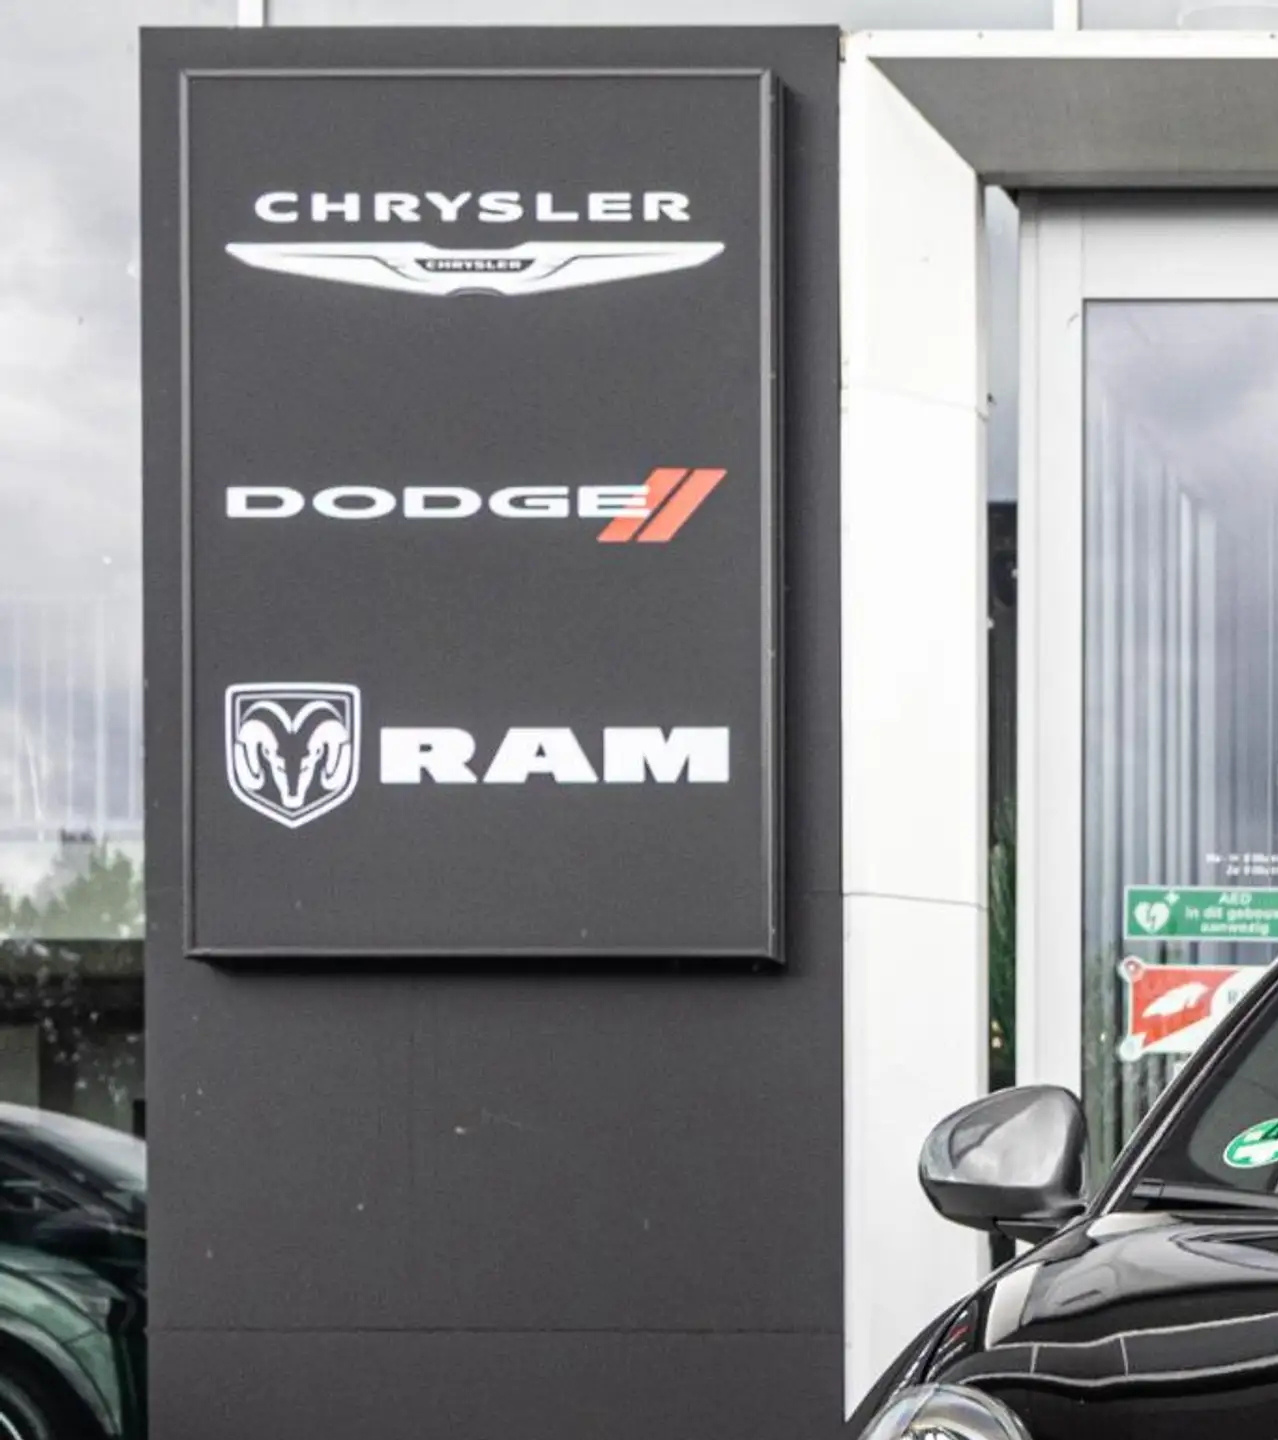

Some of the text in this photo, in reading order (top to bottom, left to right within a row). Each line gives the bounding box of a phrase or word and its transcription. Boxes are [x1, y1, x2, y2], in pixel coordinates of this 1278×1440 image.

[254, 191, 690, 223] CHRYSLER
[425, 259, 522, 270] CHRYSLER
[226, 485, 650, 518] DODGE
[380, 727, 729, 783] RAM
[1219, 892, 1252, 905] AED
[1203, 906, 1224, 920] dit
[1200, 922, 1270, 935] aanwezig
